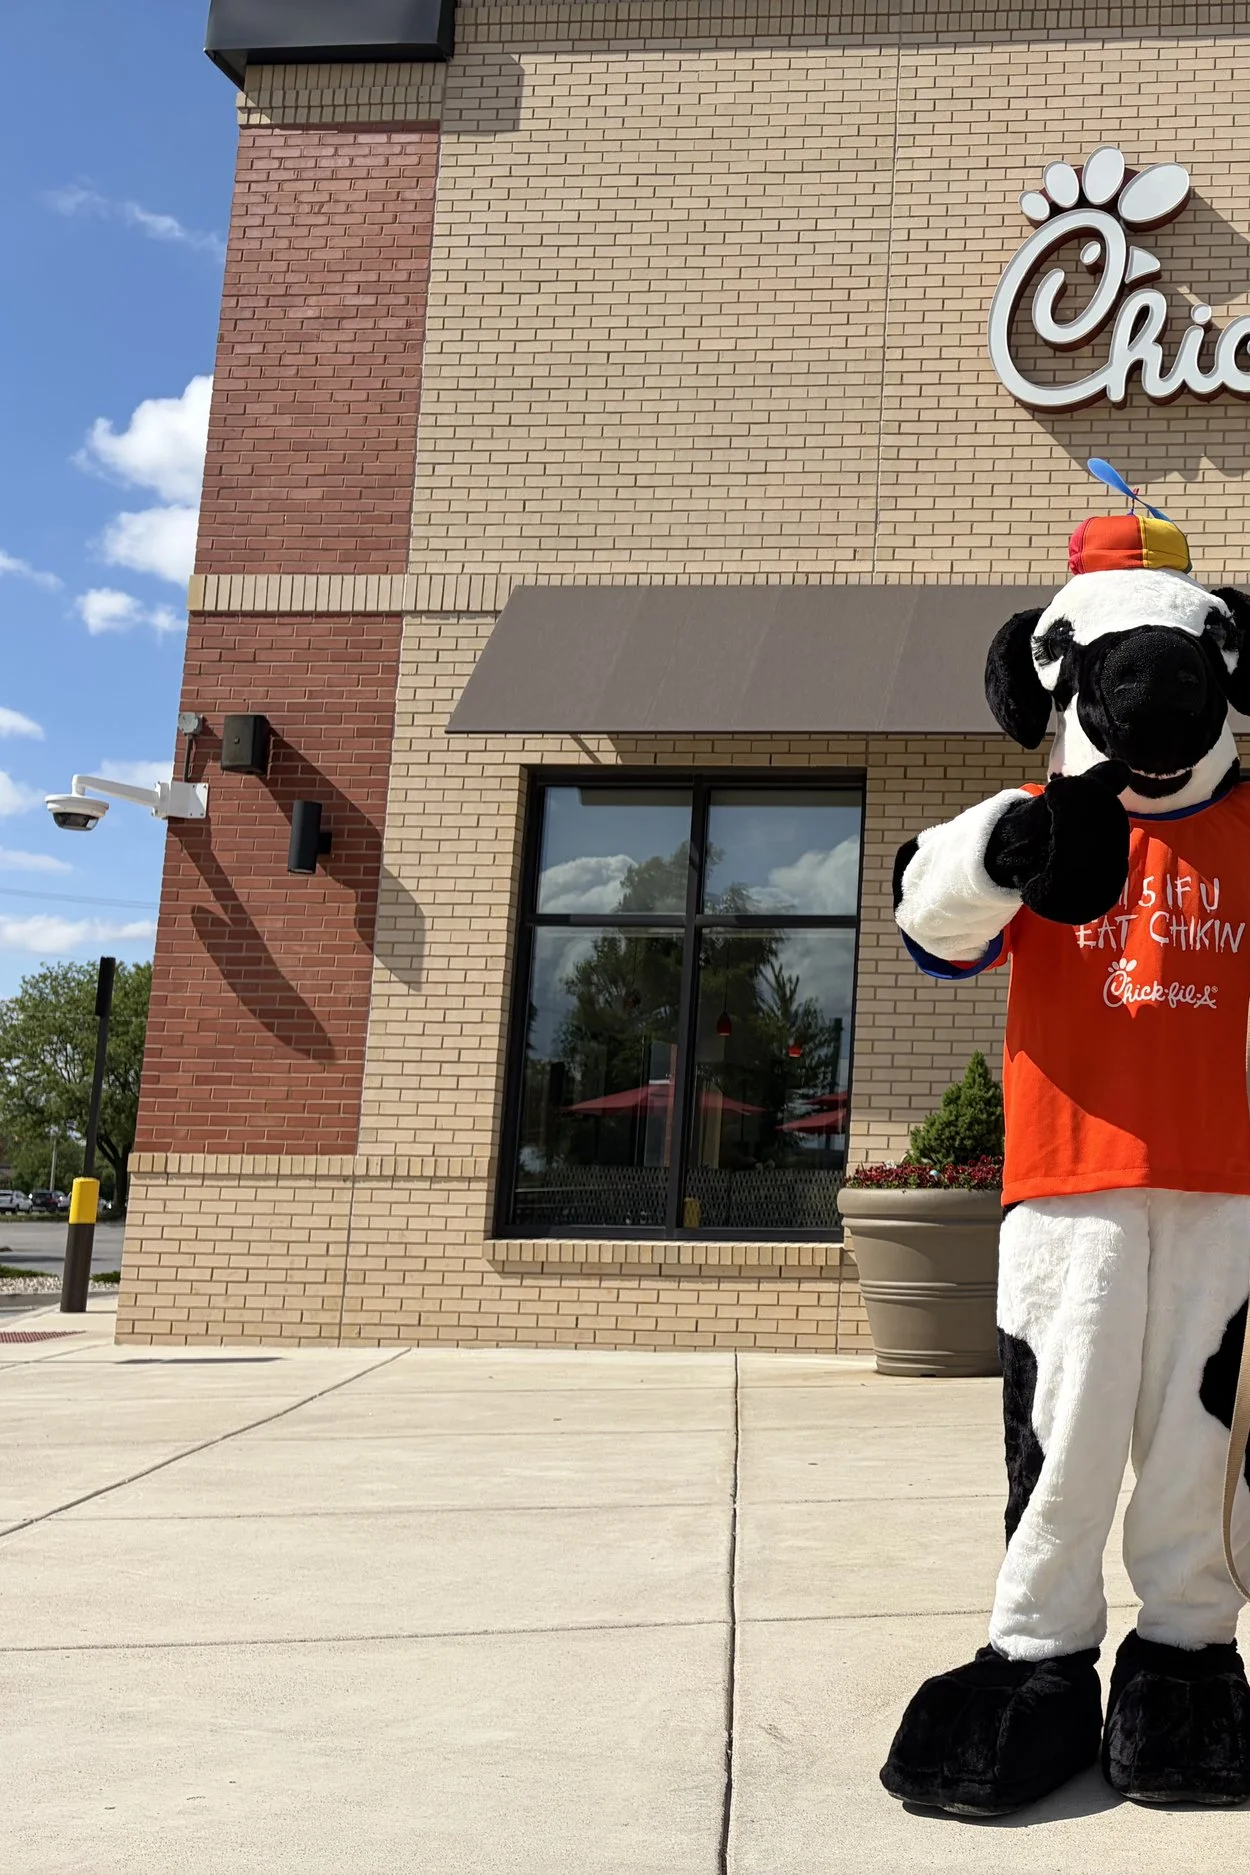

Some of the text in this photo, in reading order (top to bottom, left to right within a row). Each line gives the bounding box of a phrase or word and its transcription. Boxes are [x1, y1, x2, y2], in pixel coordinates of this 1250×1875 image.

[1200, 877, 1220, 913] U
[1075, 911, 1246, 953] EAT CHIKIN
[1103, 968, 1218, 1008] Chick-fil-A
